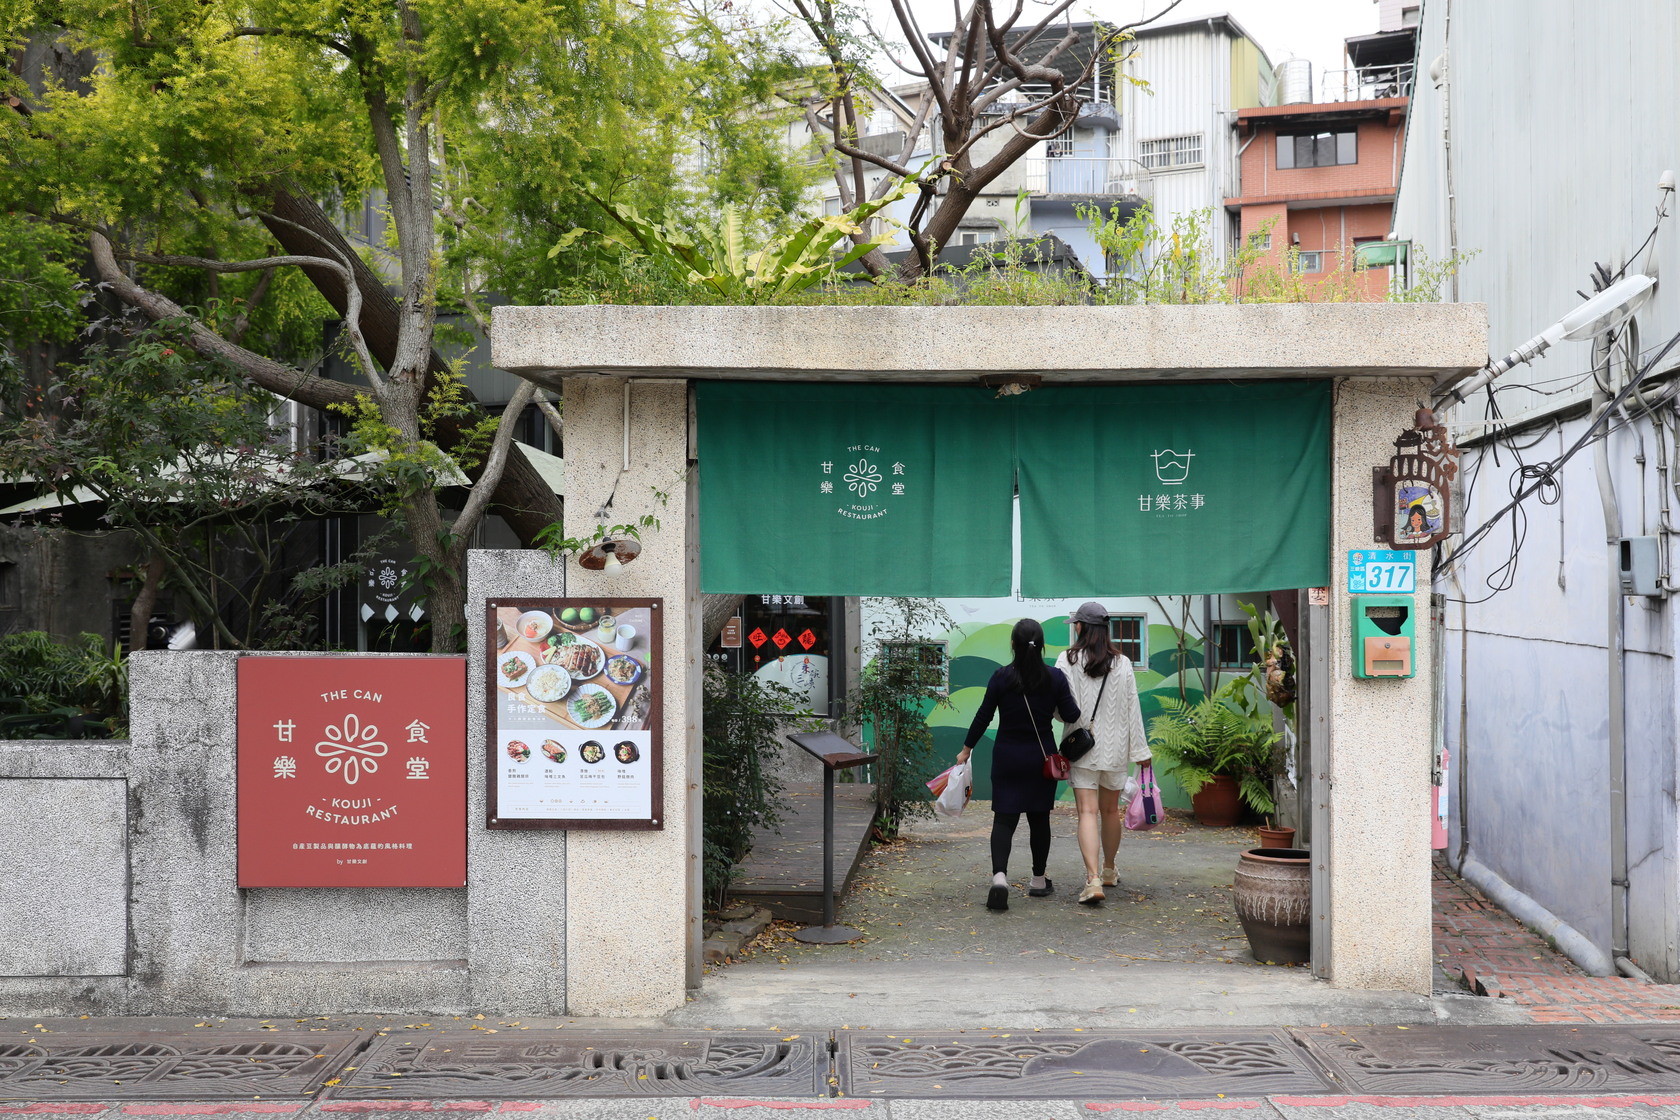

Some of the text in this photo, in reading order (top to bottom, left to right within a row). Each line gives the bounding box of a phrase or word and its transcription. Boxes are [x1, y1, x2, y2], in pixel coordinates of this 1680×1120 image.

[864, 445, 880, 453] CAN
[820, 461, 833, 494] 甘樂
[892, 461, 905, 495] 食堂
[1137, 493, 1205, 511] 甘樂茶事
[838, 508, 887, 520] RESTAURANT
[1368, 552, 1412, 560] 清水街
[1369, 566, 1410, 588] 317
[761, 594, 804, 605] 甘樂文創
[321, 689, 382, 703] THE CAN
[507, 704, 546, 713] 手作定食
[273, 719, 296, 779] 甘樂
[405, 719, 430, 779] 食堂
[331, 798, 371, 809] KOUJI
[306, 805, 398, 825] RESTAURANT
